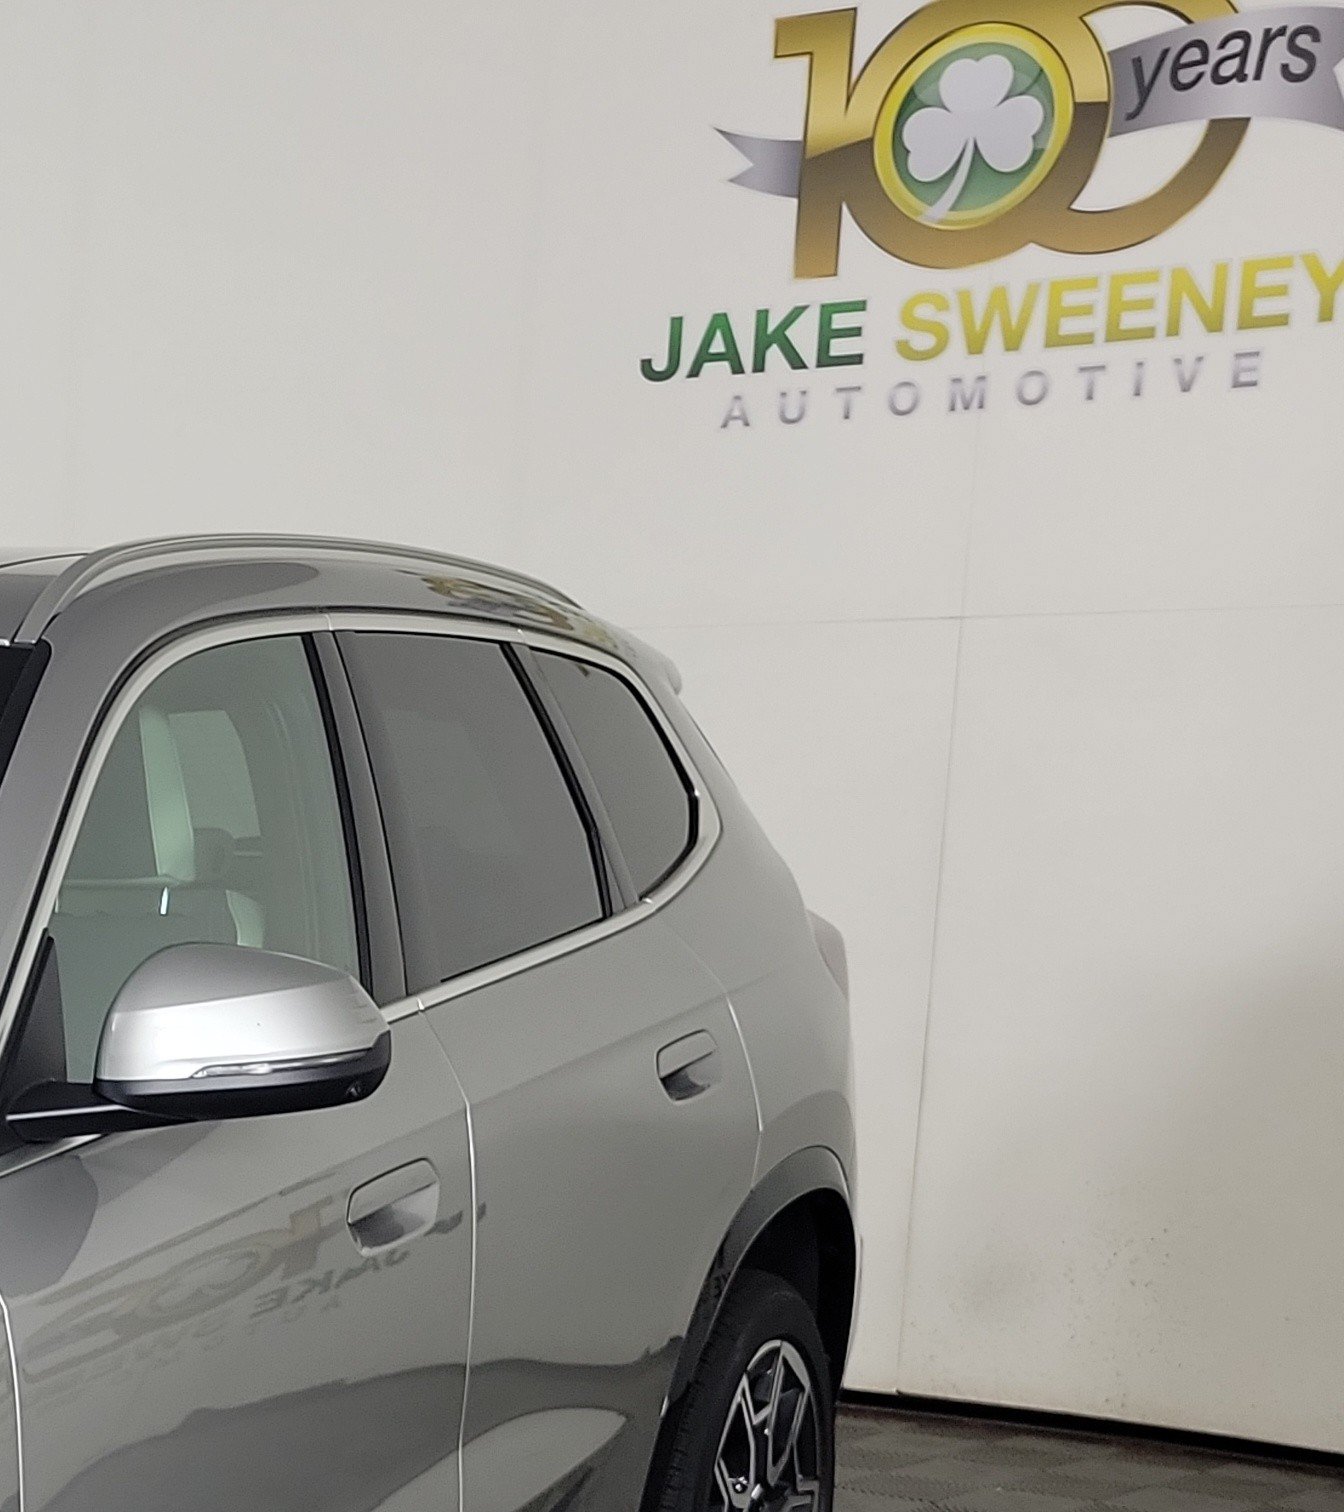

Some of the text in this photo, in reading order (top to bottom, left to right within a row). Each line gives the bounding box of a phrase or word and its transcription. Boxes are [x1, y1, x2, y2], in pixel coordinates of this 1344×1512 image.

[1124, 21, 1324, 121] years
[639, 251, 1344, 383] JAKE SWEENEY
[719, 350, 1263, 429] AUTOMOTIVE
